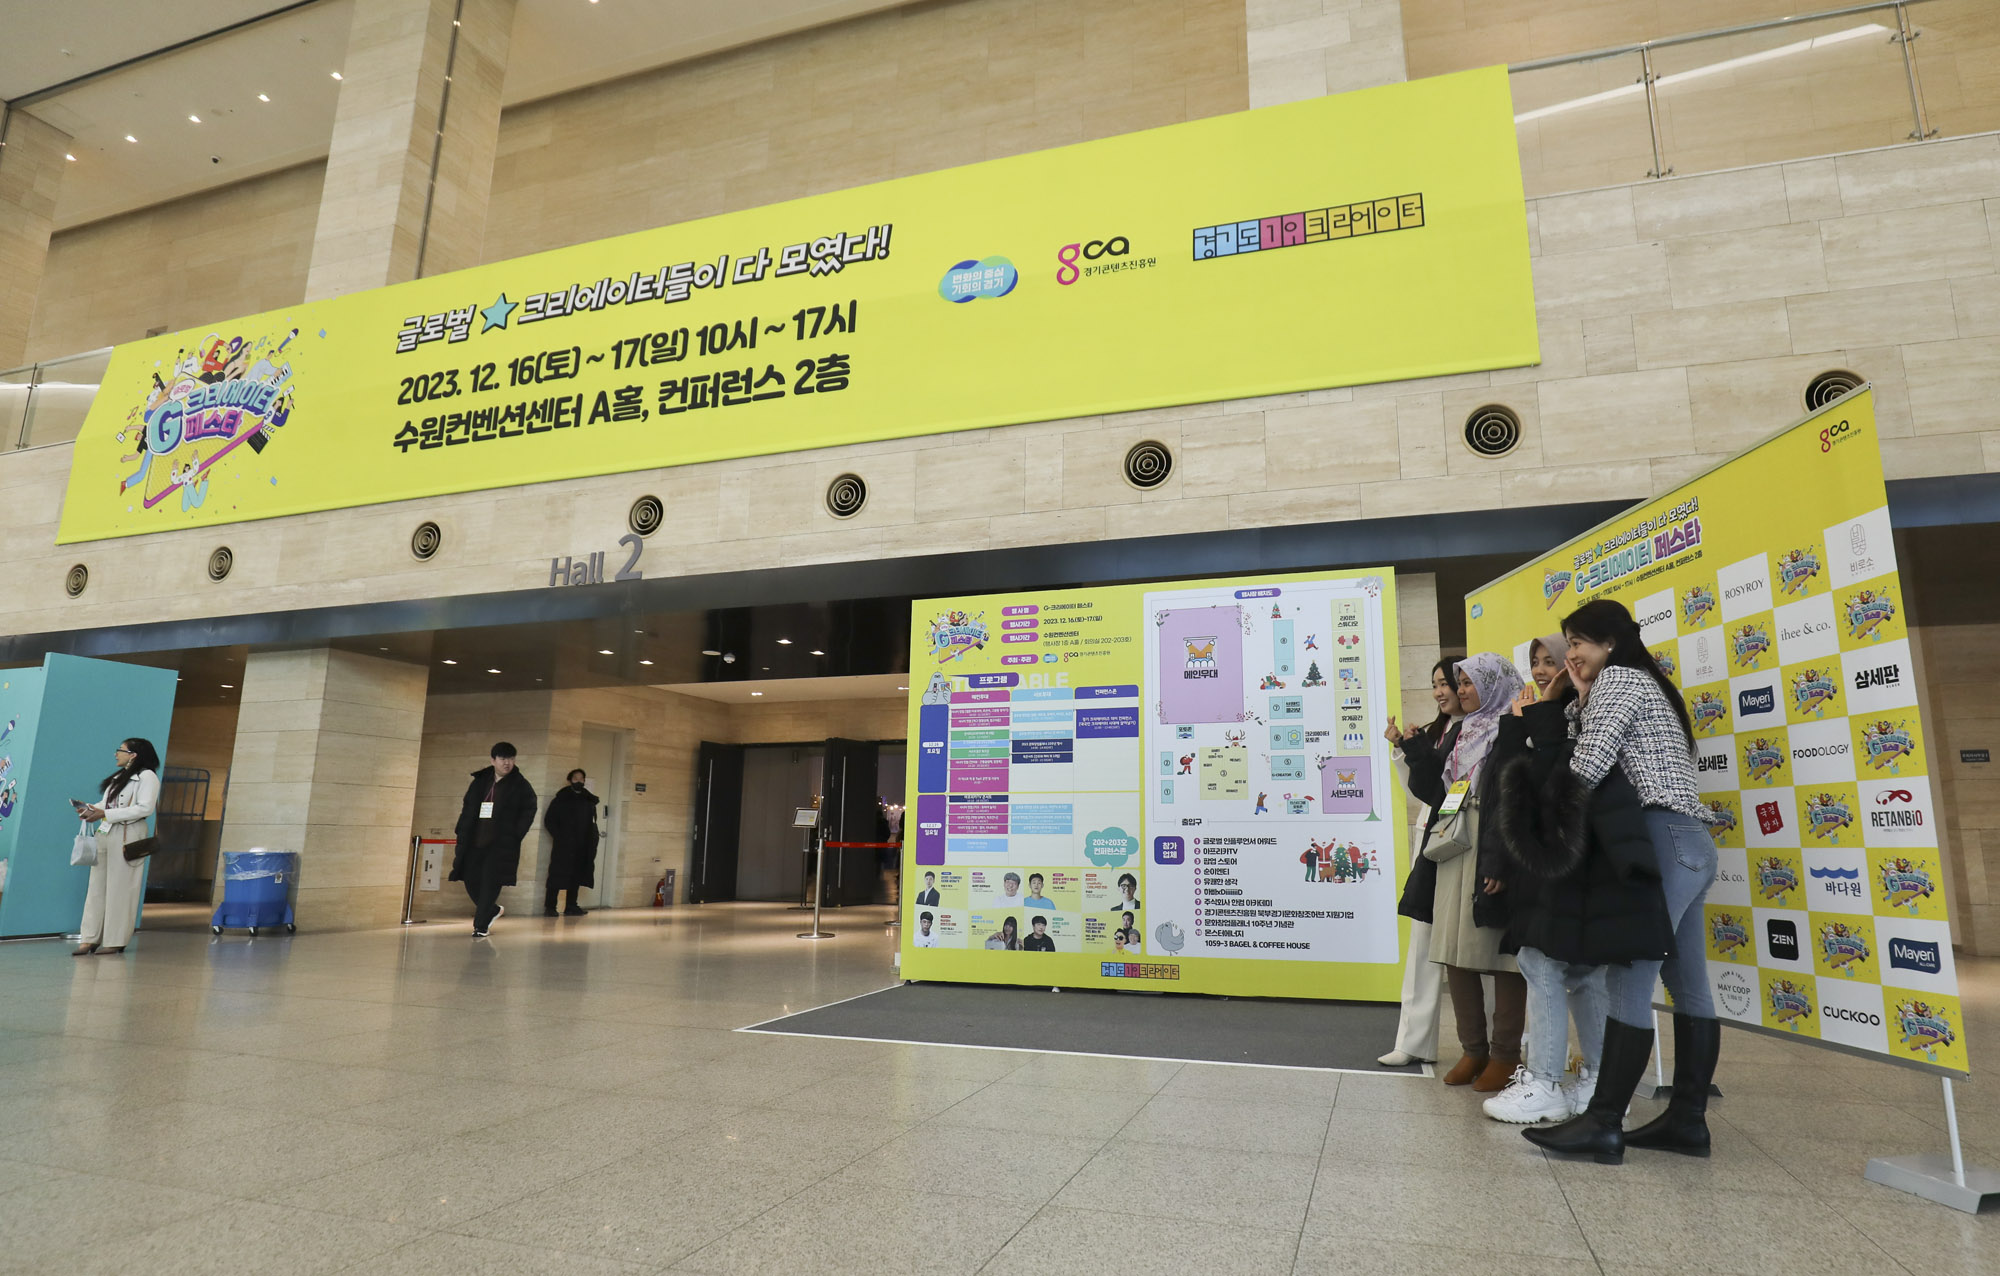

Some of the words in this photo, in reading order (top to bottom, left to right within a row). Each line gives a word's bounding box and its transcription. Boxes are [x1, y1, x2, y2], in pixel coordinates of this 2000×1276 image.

[952, 270, 982, 284] 변화의
[983, 267, 1004, 280] 중심
[1084, 257, 1157, 277] 경기콘텐츠진흥원
[396, 304, 476, 353] 글로벌
[517, 255, 728, 324] 크리에이터들이
[732, 247, 772, 285] 다
[775, 223, 893, 278] 모였다!
[952, 281, 981, 295] 기회의
[983, 278, 1004, 291] 경기
[397, 368, 462, 406] 2023.
[470, 362, 500, 393] 12.
[508, 346, 582, 387] 16(토)
[611, 327, 689, 370] 17(일)
[696, 316, 758, 356] 10시
[792, 299, 857, 341] 17시
[393, 393, 583, 453] 수원컨벤션센터
[588, 384, 649, 425] A홀,
[658, 364, 786, 416] 컨퍼런스
[793, 353, 850, 396] 2층
[150, 399, 184, 454] G
[184, 409, 243, 440] 페스타
[1573, 548, 1594, 570] 글로벌
[1604, 516, 1657, 554] 크리에이터들이
[1658, 512, 1668, 528] 다
[1669, 496, 1699, 522] 모였다!
[549, 551, 604, 586] Hall
[615, 533, 643, 582] 2
[1575, 538, 1653, 594] G-크리에이터
[1653, 516, 1702, 560] 페스타
[1850, 557, 1875, 573] 비로소
[1724, 578, 1765, 600] ROSYROY
[1639, 609, 1672, 628] CUCKOO
[1780, 628, 1801, 641] ihee
[1803, 622, 1814, 634] &
[1816, 623, 1831, 632] co.
[1184, 669, 1218, 680] 메인무대
[1854, 664, 1900, 690] 삼세판
[1742, 691, 1771, 711] Mayeri
[1793, 744, 1849, 759] FOODOLOGY
[1697, 753, 1728, 772] 삼세판
[1331, 789, 1364, 798] 서브무대
[1181, 818, 1202, 826] 출입구
[1092, 838, 1128, 847] 202+203호
[1162, 842, 1177, 850] 참가
[1203, 837, 1223, 845] 글로벌
[1223, 837, 1256, 845] 인플루언서
[1257, 837, 1277, 845] 어워드
[1093, 847, 1127, 856] 컨퍼런스존
[1203, 847, 1238, 855] 아프리카TV
[1217, 857, 1237, 866] 스토어
[1224, 878, 1238, 886] 생각
[1732, 874, 1745, 882] co.
[1825, 880, 1861, 897] 바다원
[1204, 909, 1257, 918] 경기콘텐츠진흥원
[1205, 940, 1228, 948] 1059-3
[1229, 940, 1251, 948] BAGEL
[1259, 941, 1285, 949] COFFEE
[1771, 934, 1794, 945] ZEN
[1894, 943, 1935, 963] Mayeri
[1717, 983, 1731, 992] MAY
[1732, 986, 1751, 995] COOP
[1823, 1005, 1881, 1026] CUCKOO
